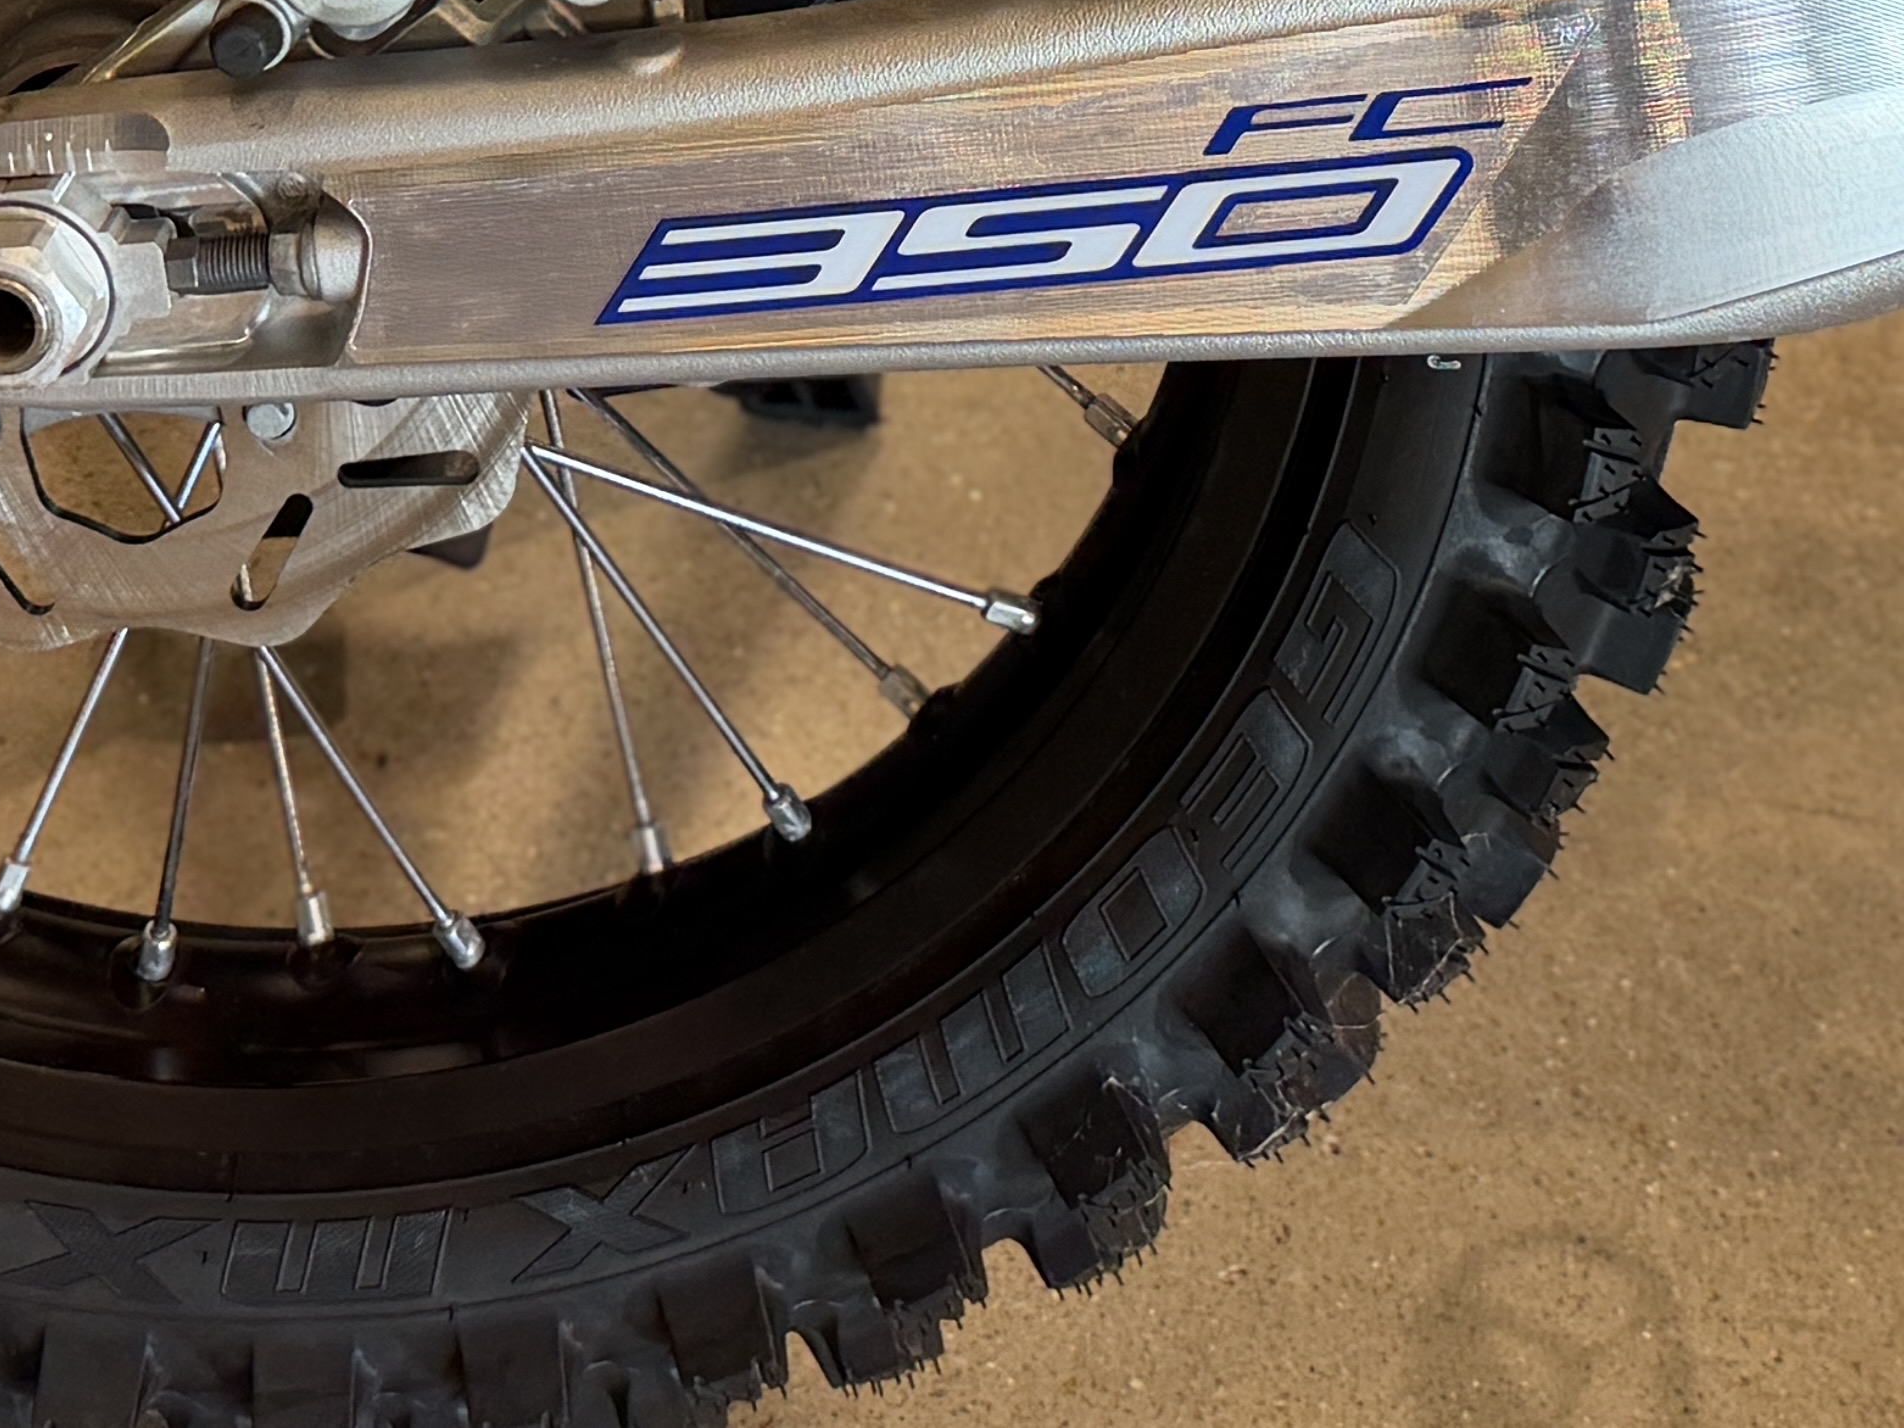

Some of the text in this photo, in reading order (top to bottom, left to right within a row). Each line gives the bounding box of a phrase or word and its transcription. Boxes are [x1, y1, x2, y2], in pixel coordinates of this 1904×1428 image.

[1203, 76, 1532, 156] FC
[594, 145, 1477, 326] 350
[508, 518, 1402, 1285] GEOMAX
